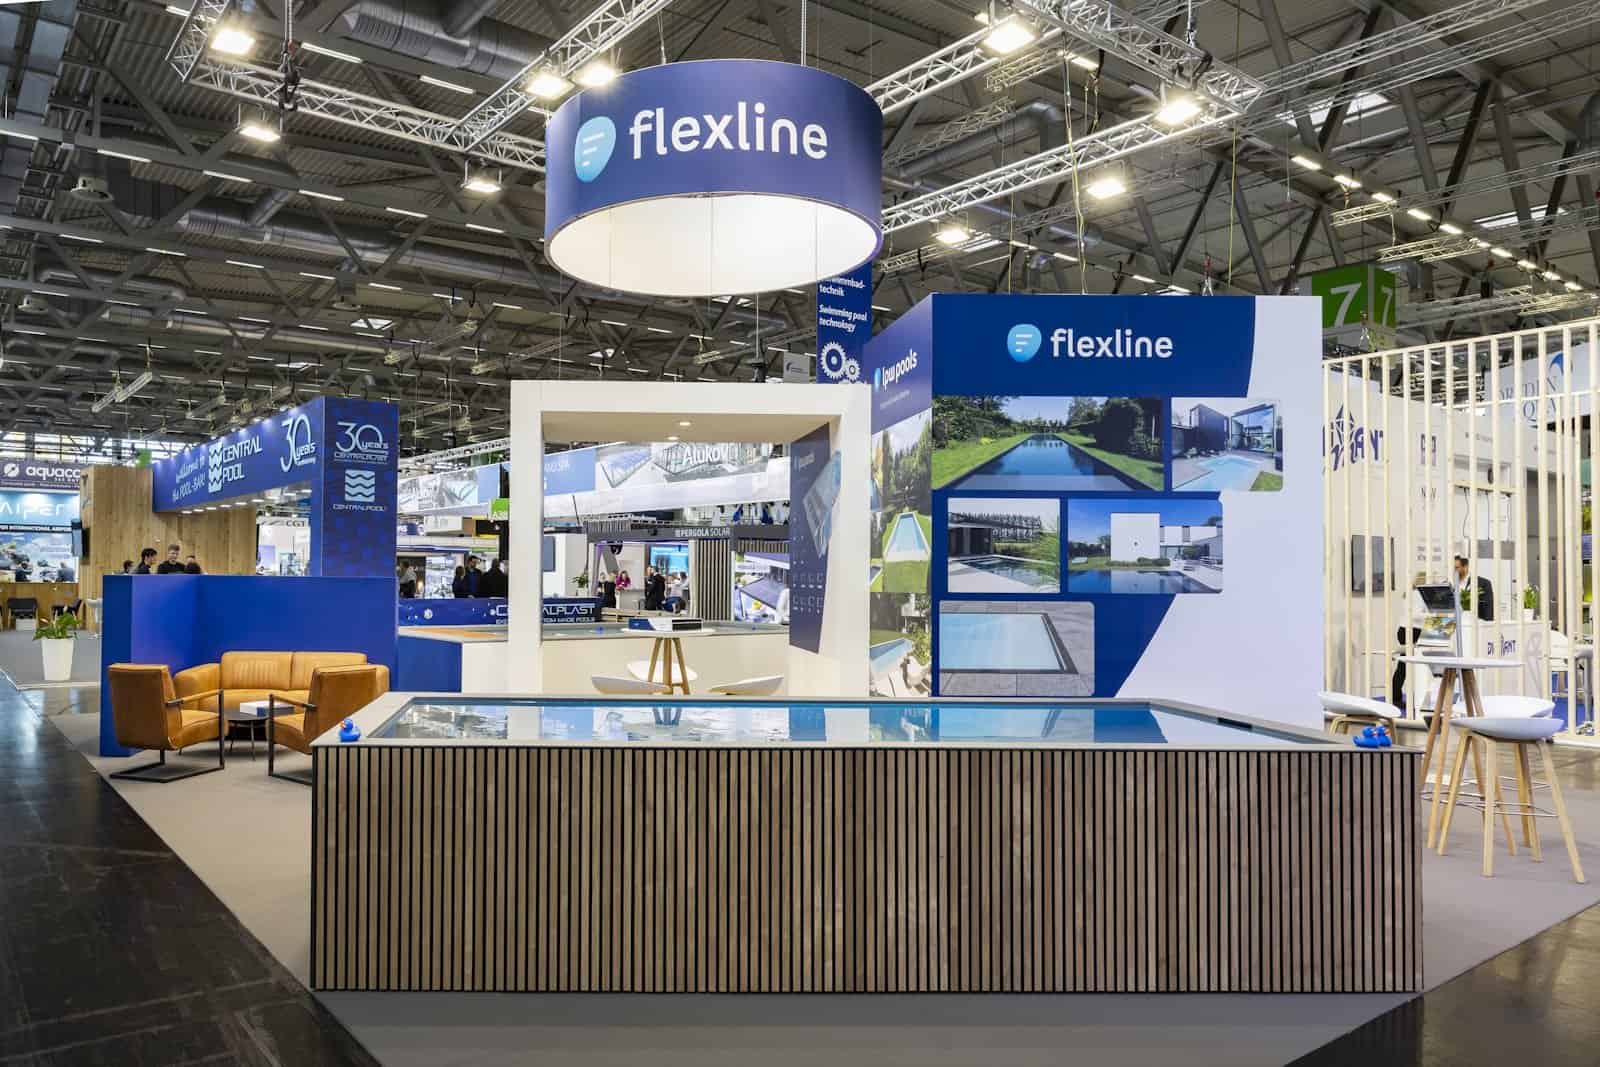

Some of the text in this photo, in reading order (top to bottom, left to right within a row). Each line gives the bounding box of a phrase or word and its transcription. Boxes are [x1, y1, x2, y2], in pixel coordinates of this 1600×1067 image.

[629, 101, 828, 160] flexline
[819, 284, 845, 297] technik
[1330, 282, 1362, 328] 7
[819, 303, 868, 322] Swimming pool
[1381, 286, 1393, 327] 7
[819, 317, 856, 333] technology
[1050, 328, 1174, 358] flexline
[222, 435, 263, 463] CENTRAL
[280, 413, 312, 472] 30
[336, 421, 383, 453] 30
[222, 463, 245, 484] POOL
[680, 527, 731, 538] PERGOLA SOLAR
